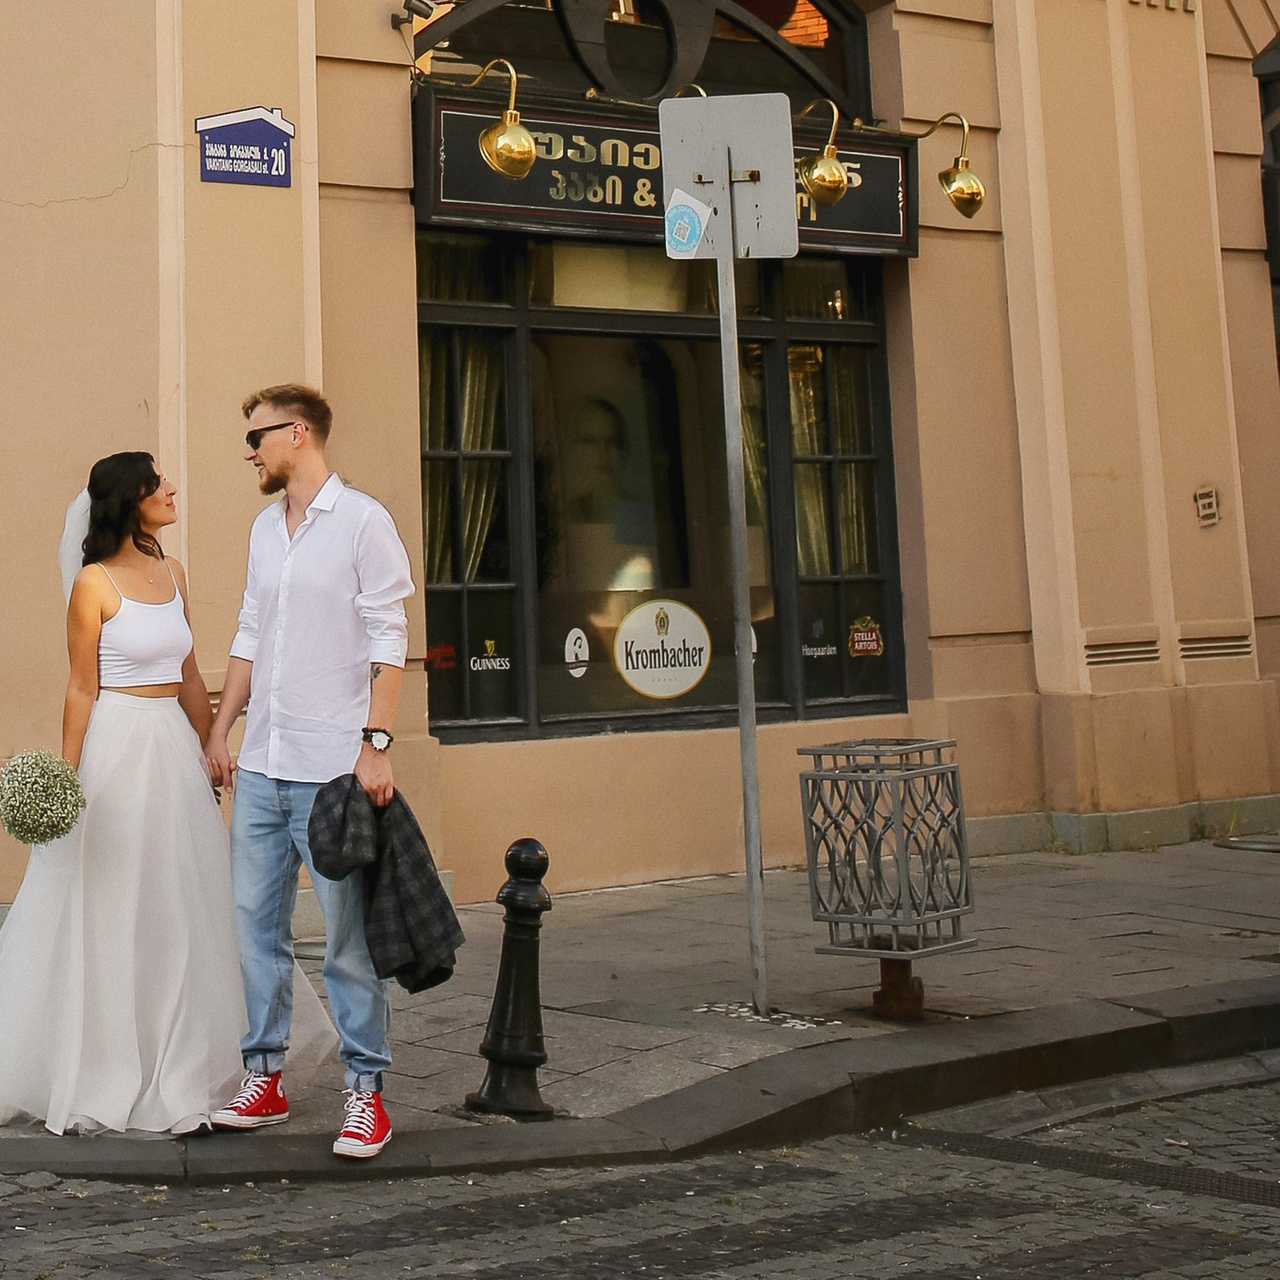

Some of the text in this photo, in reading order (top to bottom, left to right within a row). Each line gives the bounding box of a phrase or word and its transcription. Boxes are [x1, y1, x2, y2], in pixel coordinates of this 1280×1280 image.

[271, 148, 286, 176] 20
[633, 178, 657, 207] &
[854, 632, 877, 642] STELLA
[854, 641, 878, 650] ARTOIS
[470, 656, 510, 671] GUINNESS
[624, 638, 705, 671] Krombacher
